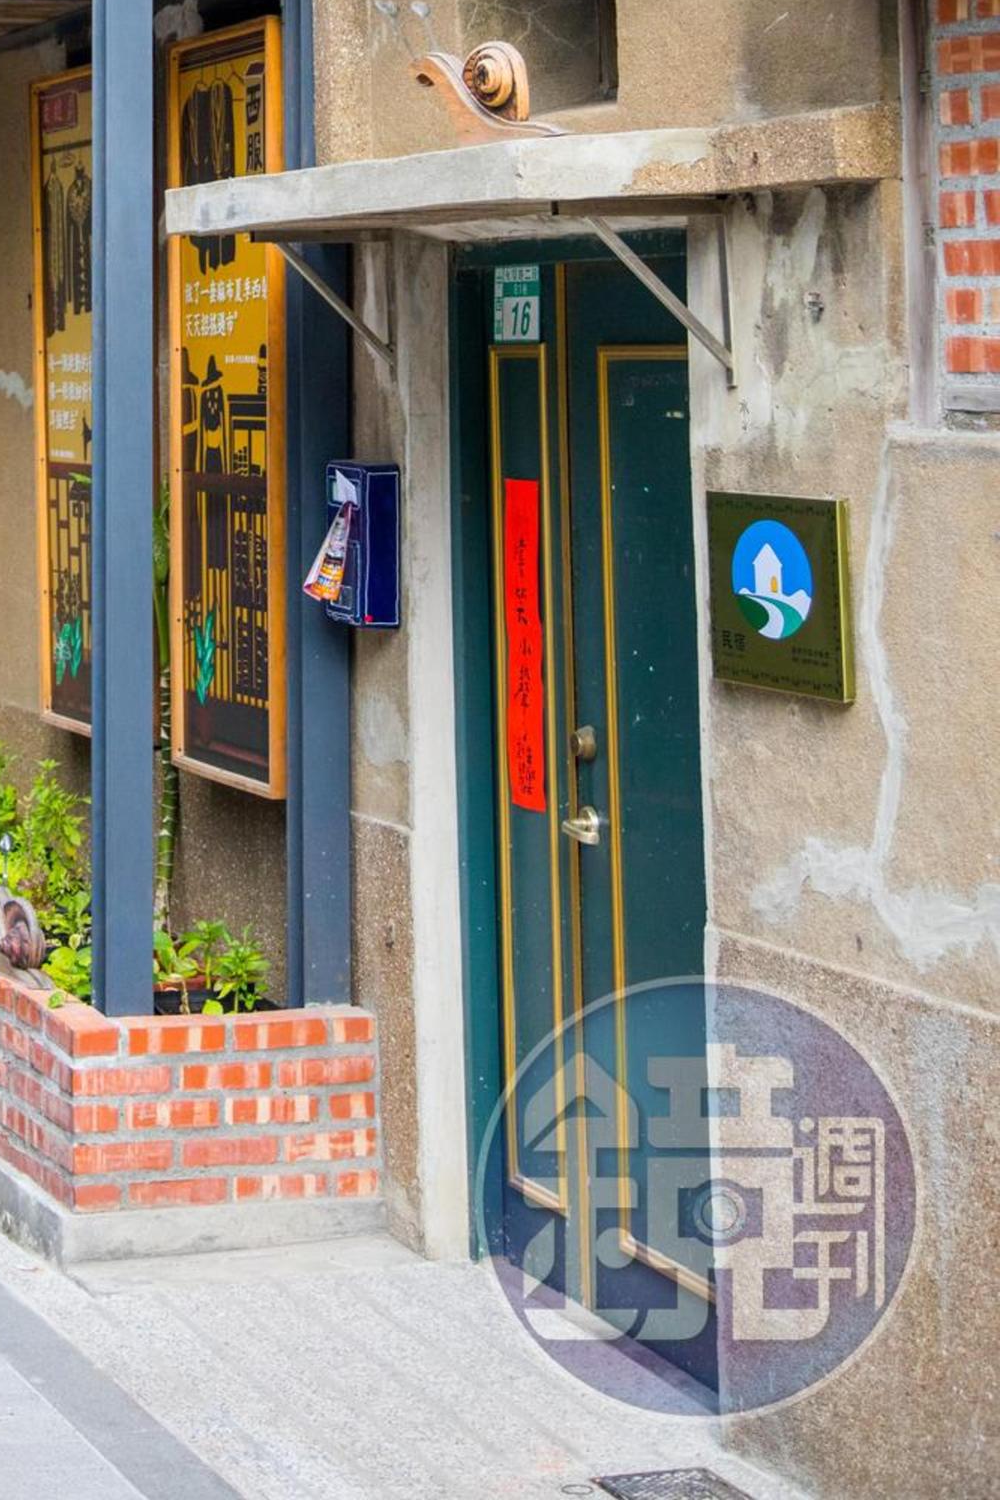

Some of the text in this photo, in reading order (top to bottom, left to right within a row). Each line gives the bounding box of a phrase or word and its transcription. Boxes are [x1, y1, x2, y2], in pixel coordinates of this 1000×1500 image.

[246, 84, 262, 172] 西服
[512, 301, 531, 336] 16
[722, 630, 746, 652] 民宿
